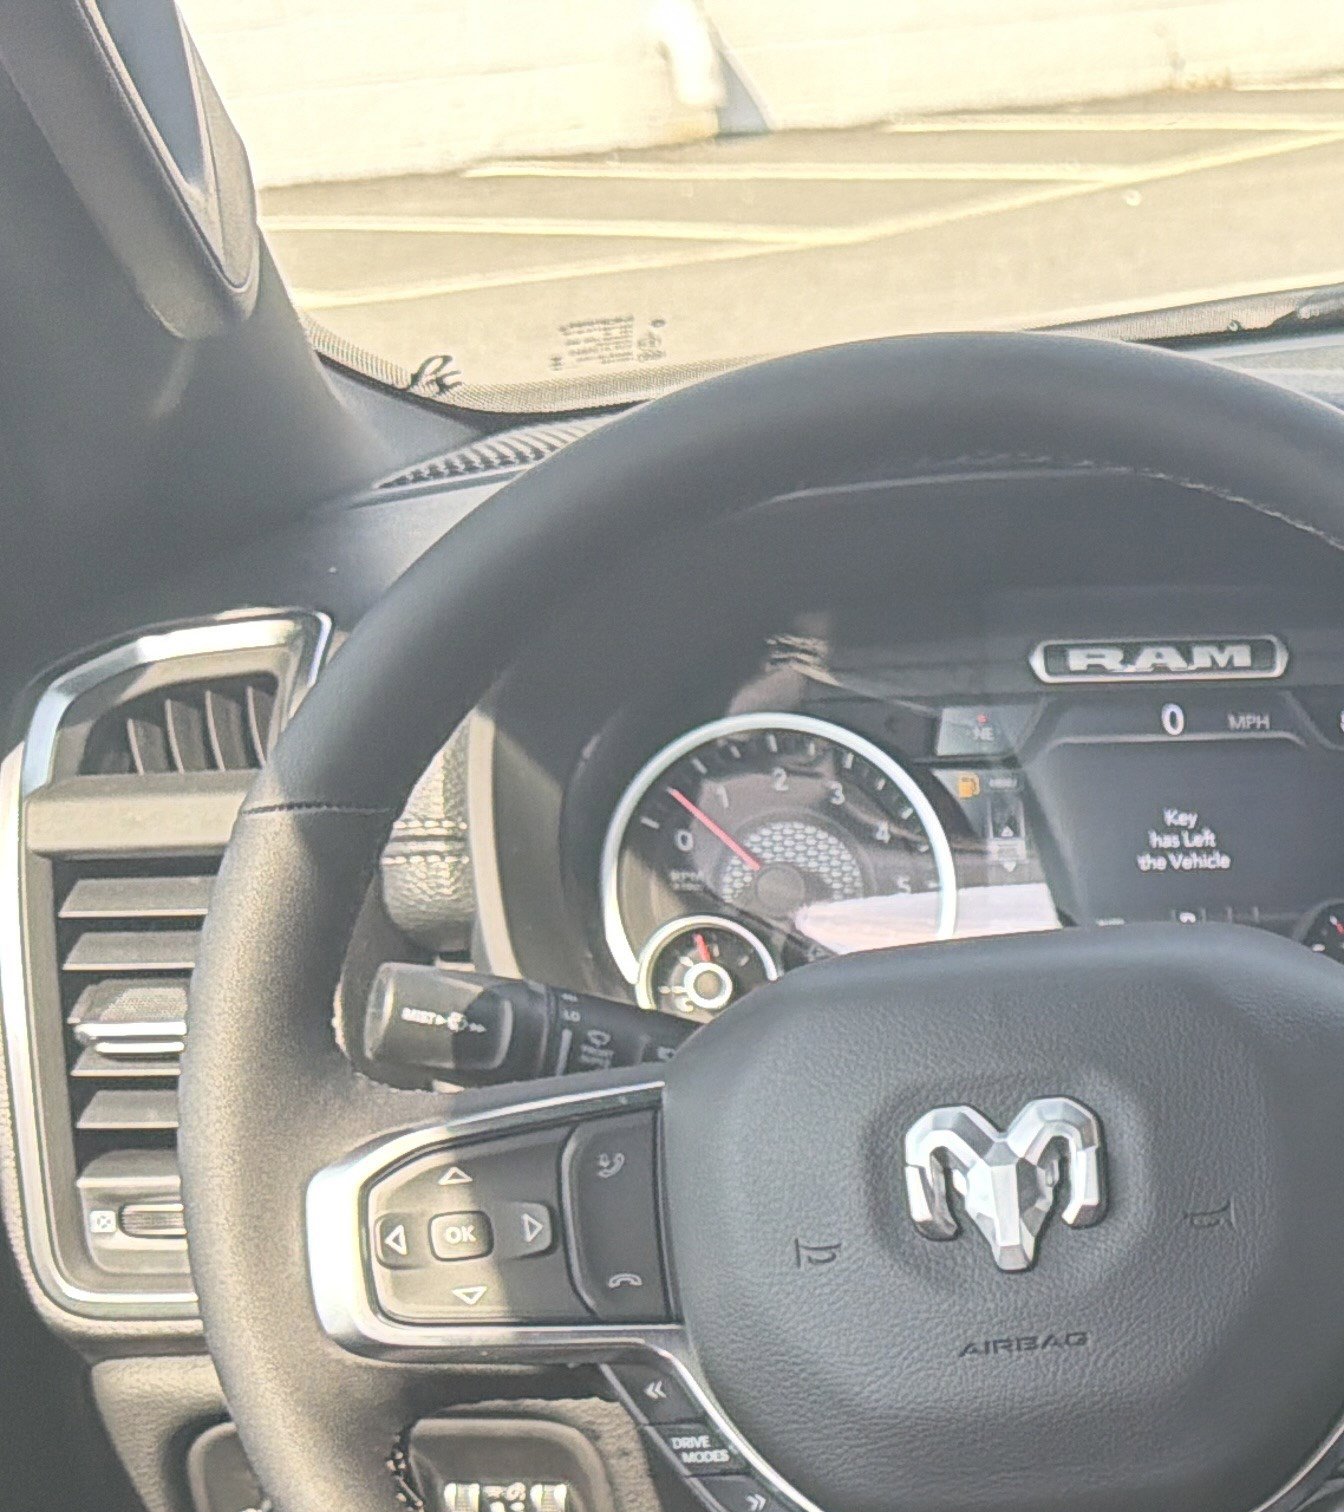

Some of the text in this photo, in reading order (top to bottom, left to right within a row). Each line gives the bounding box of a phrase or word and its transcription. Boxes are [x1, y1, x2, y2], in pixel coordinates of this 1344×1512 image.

[1067, 645, 1252, 673] RAM
[1161, 703, 1270, 736] 0 MPH
[772, 767, 789, 791] 2
[716, 785, 730, 808] 1
[829, 781, 846, 805] 3
[1163, 808, 1198, 829] Key
[675, 829, 694, 852] 0
[875, 820, 891, 844] 4
[1148, 828, 1216, 849] has Left
[1136, 850, 1232, 872] the Vehicle
[444, 1223, 476, 1243] OK
[958, 1331, 1087, 1356] AIRBAG
[671, 1435, 711, 1450] DRIVE
[682, 1448, 730, 1464] MODES
